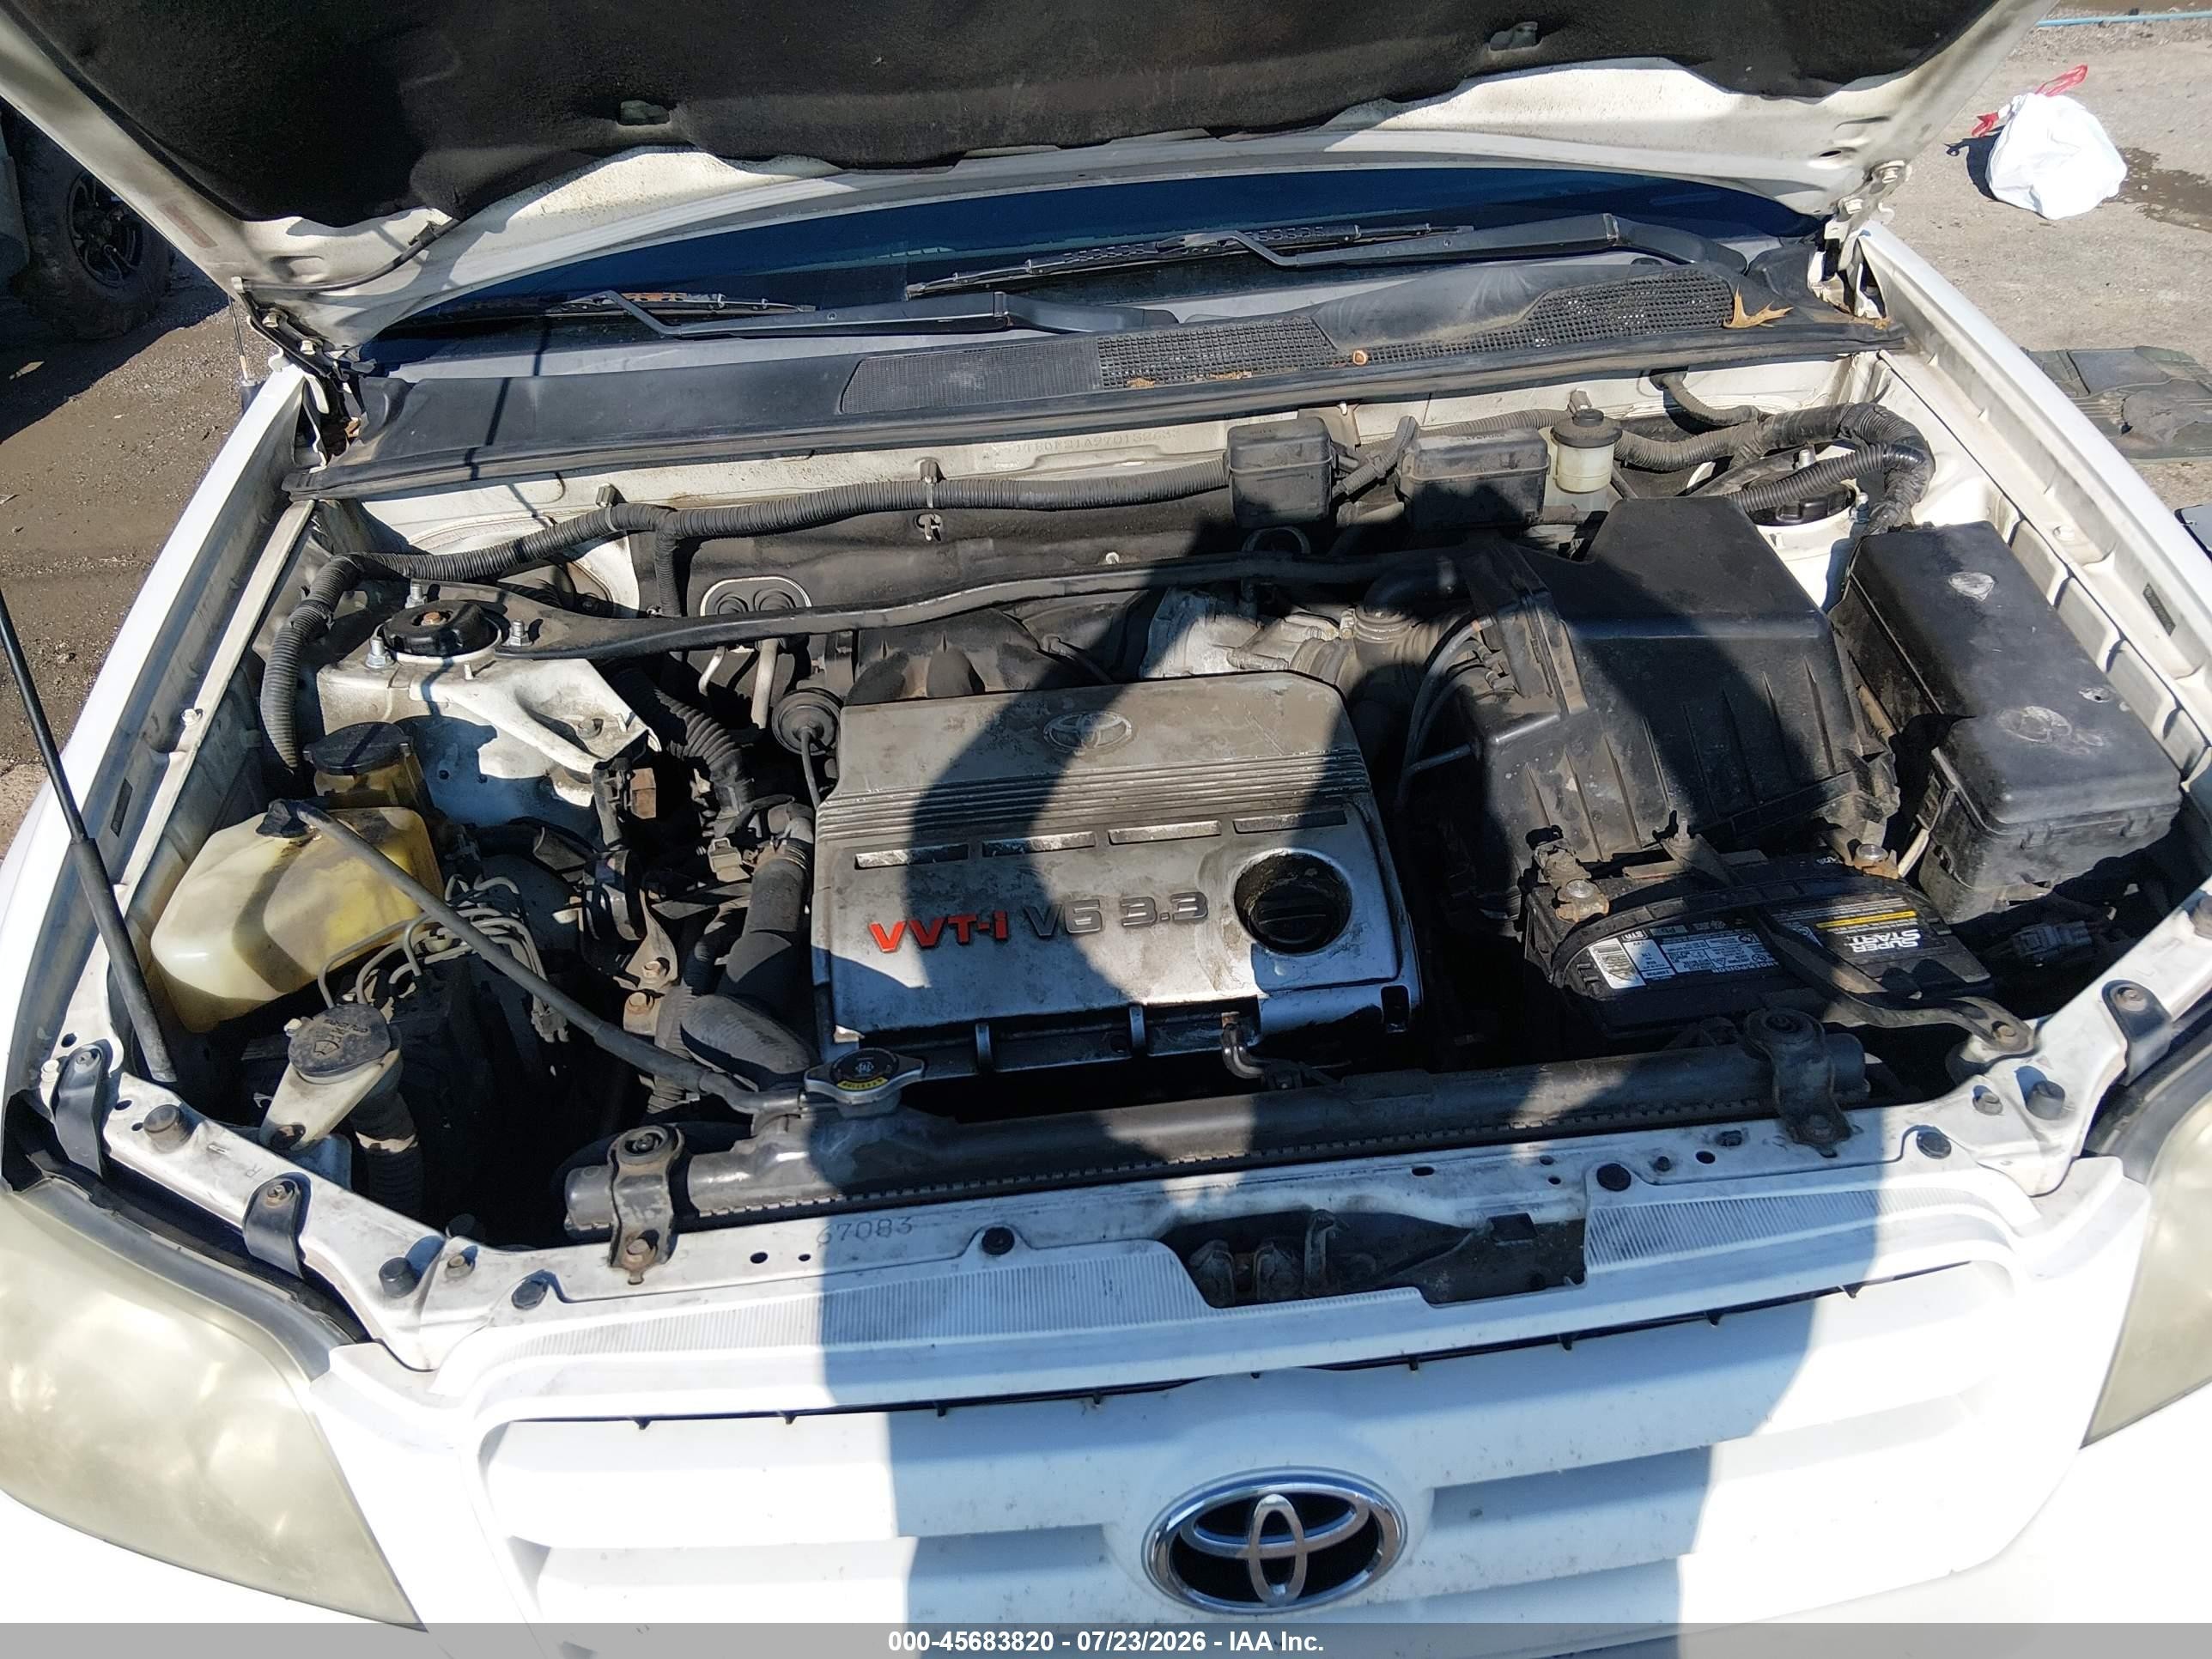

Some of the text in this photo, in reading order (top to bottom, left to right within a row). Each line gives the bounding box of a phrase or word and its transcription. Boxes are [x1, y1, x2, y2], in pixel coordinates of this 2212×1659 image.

[1023, 899, 1103, 936] V6
[1120, 891, 1209, 928] 3.3
[1848, 940, 1918, 953] SUPER
[1849, 929, 1921, 945] START
[816, 1215, 913, 1245] 67083
